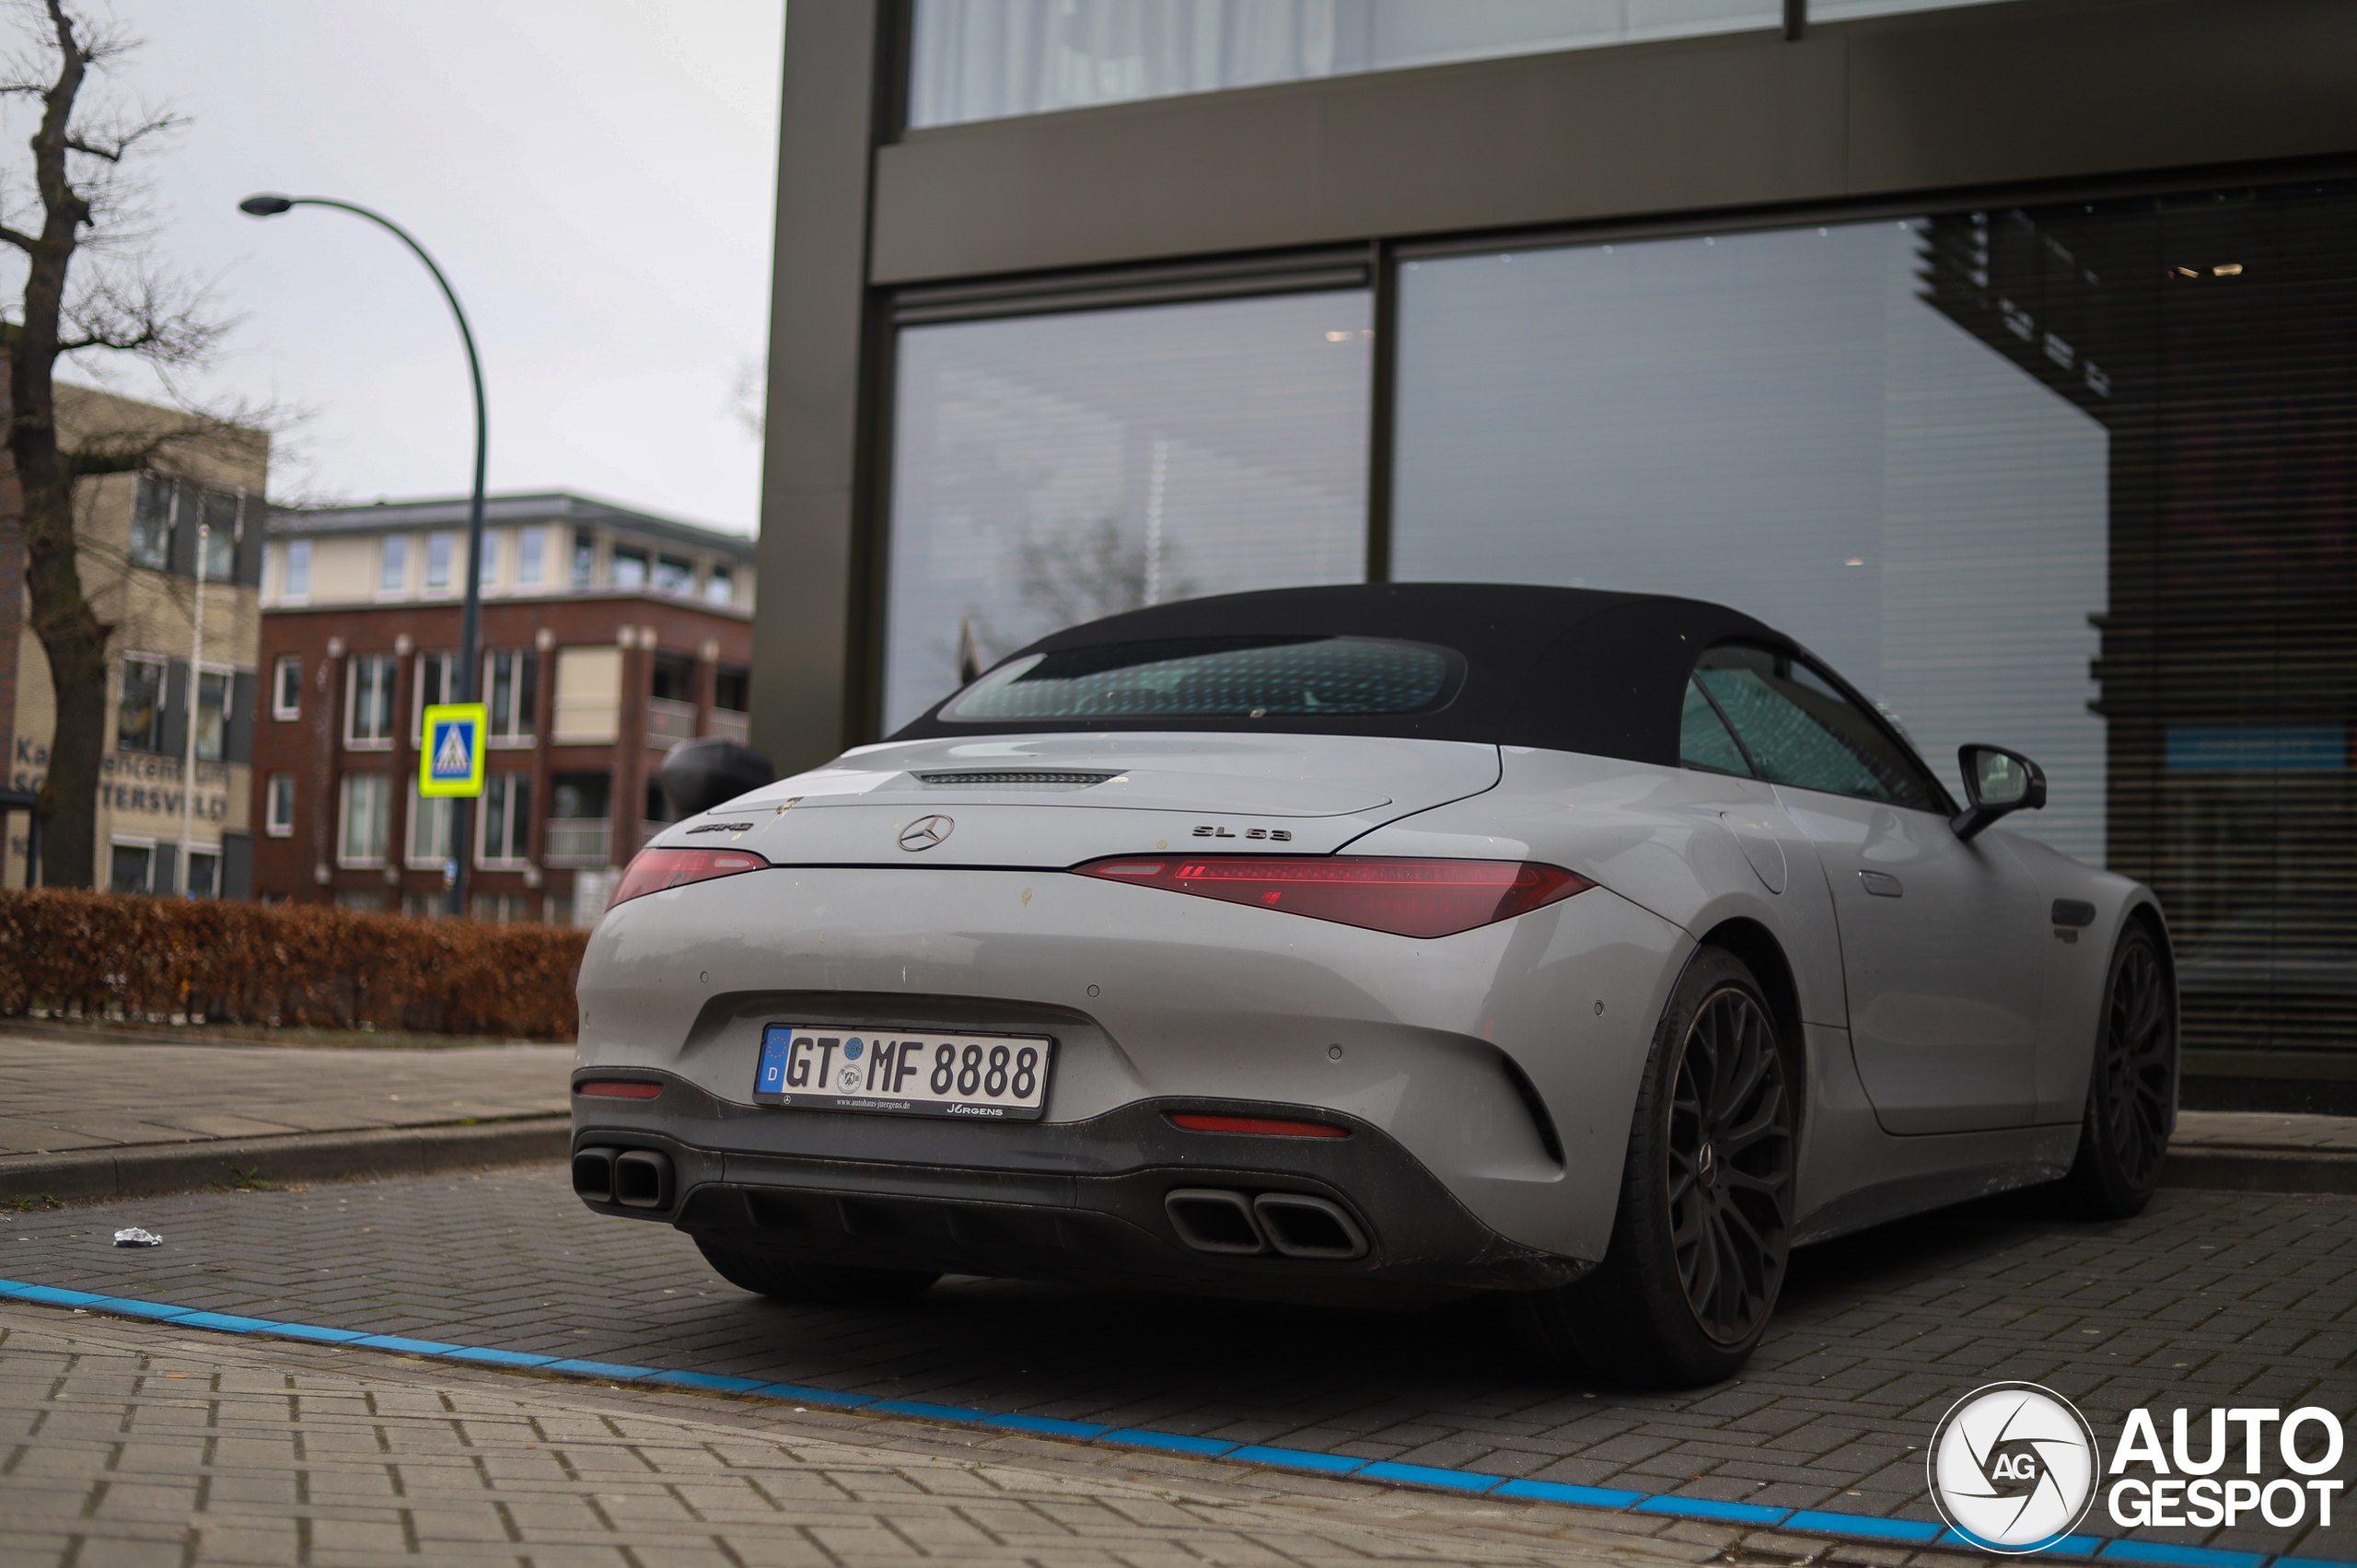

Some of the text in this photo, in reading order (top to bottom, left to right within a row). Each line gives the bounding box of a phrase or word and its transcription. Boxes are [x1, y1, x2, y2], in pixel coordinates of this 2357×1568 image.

[1192, 826, 1292, 842] SL 63
[768, 1066, 778, 1082] D
[786, 1037, 840, 1088] GT
[866, 1040, 923, 1093] MF
[930, 1043, 1039, 1098] 8888
[836, 1098, 911, 1109] www.autohaus-juergens.de
